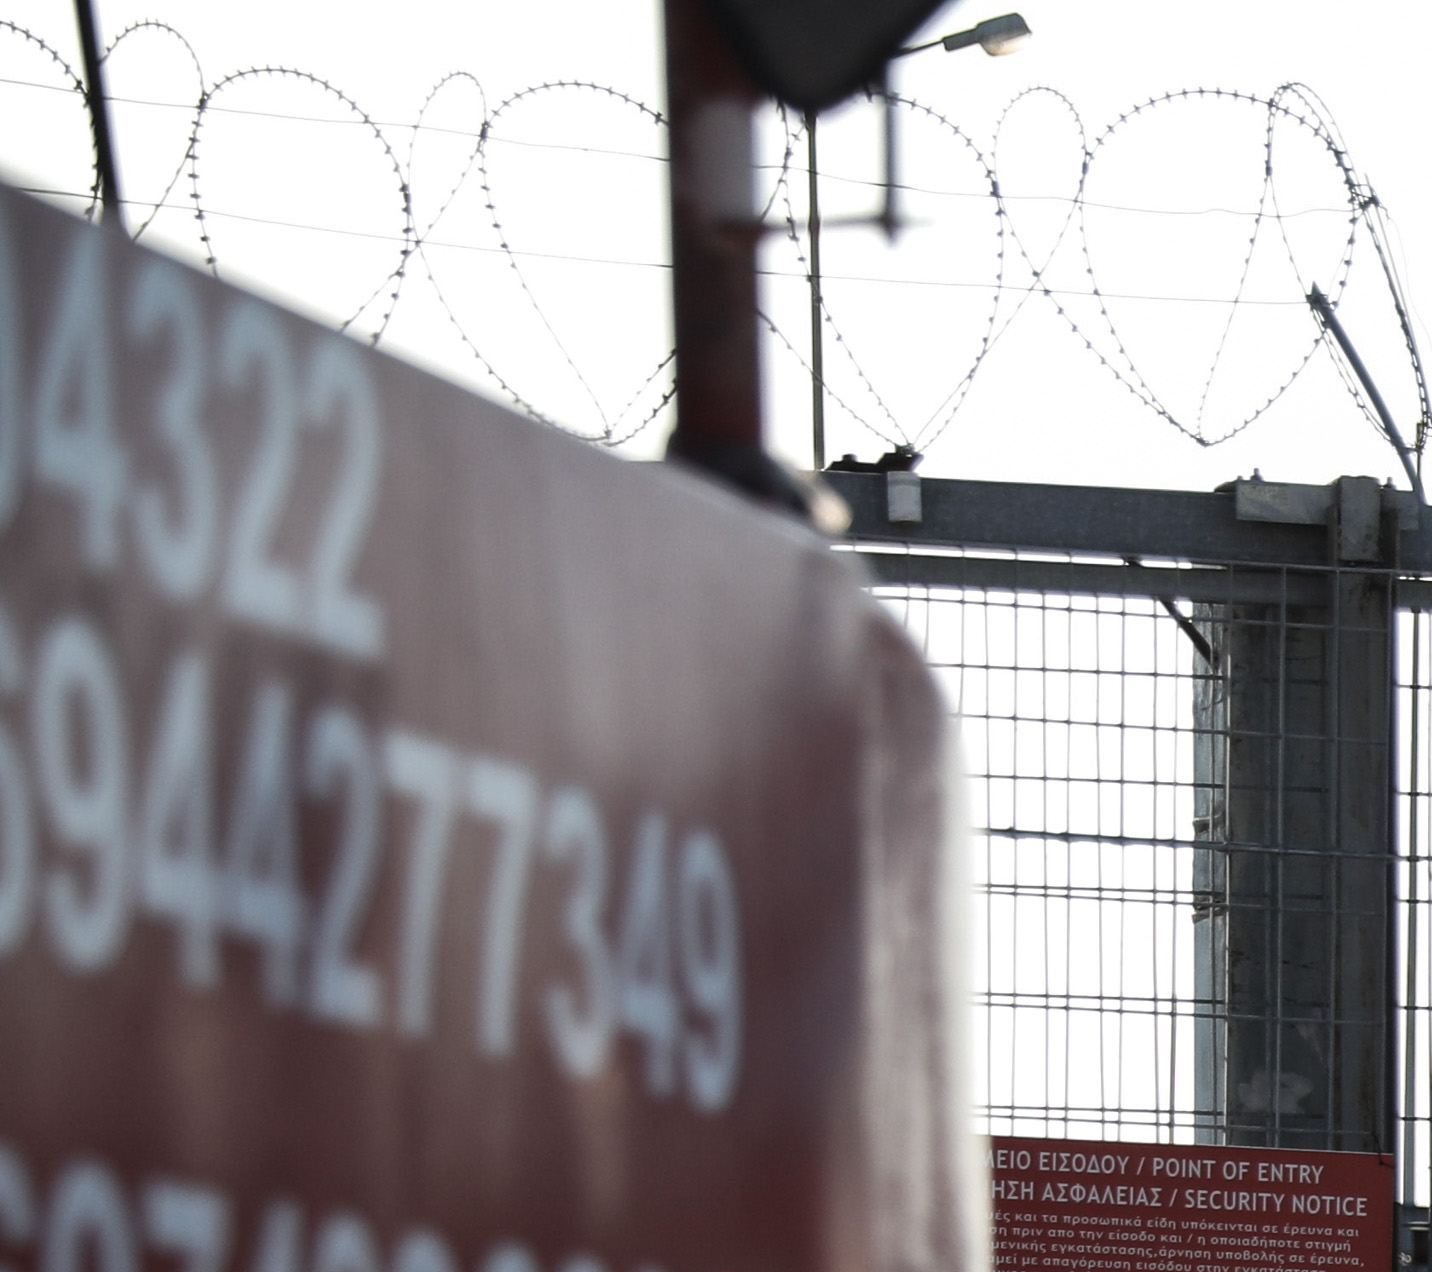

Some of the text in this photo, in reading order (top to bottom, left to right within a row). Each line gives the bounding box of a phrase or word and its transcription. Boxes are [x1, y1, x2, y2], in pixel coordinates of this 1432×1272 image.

[0, 205, 383, 660] 4322
[1039, 1151, 1130, 1175] ΕΙΣΟΔΟΥ
[1152, 1157, 1216, 1179] POINT
[1222, 1160, 1250, 1180] OF
[1258, 1162, 1324, 1184] ENTRY
[1041, 1182, 1162, 1207] ΑΣΦΑΛΕΙΑΣ
[1184, 1189, 1285, 1212] SECURITY
[1292, 1194, 1368, 1217] NOTICE
